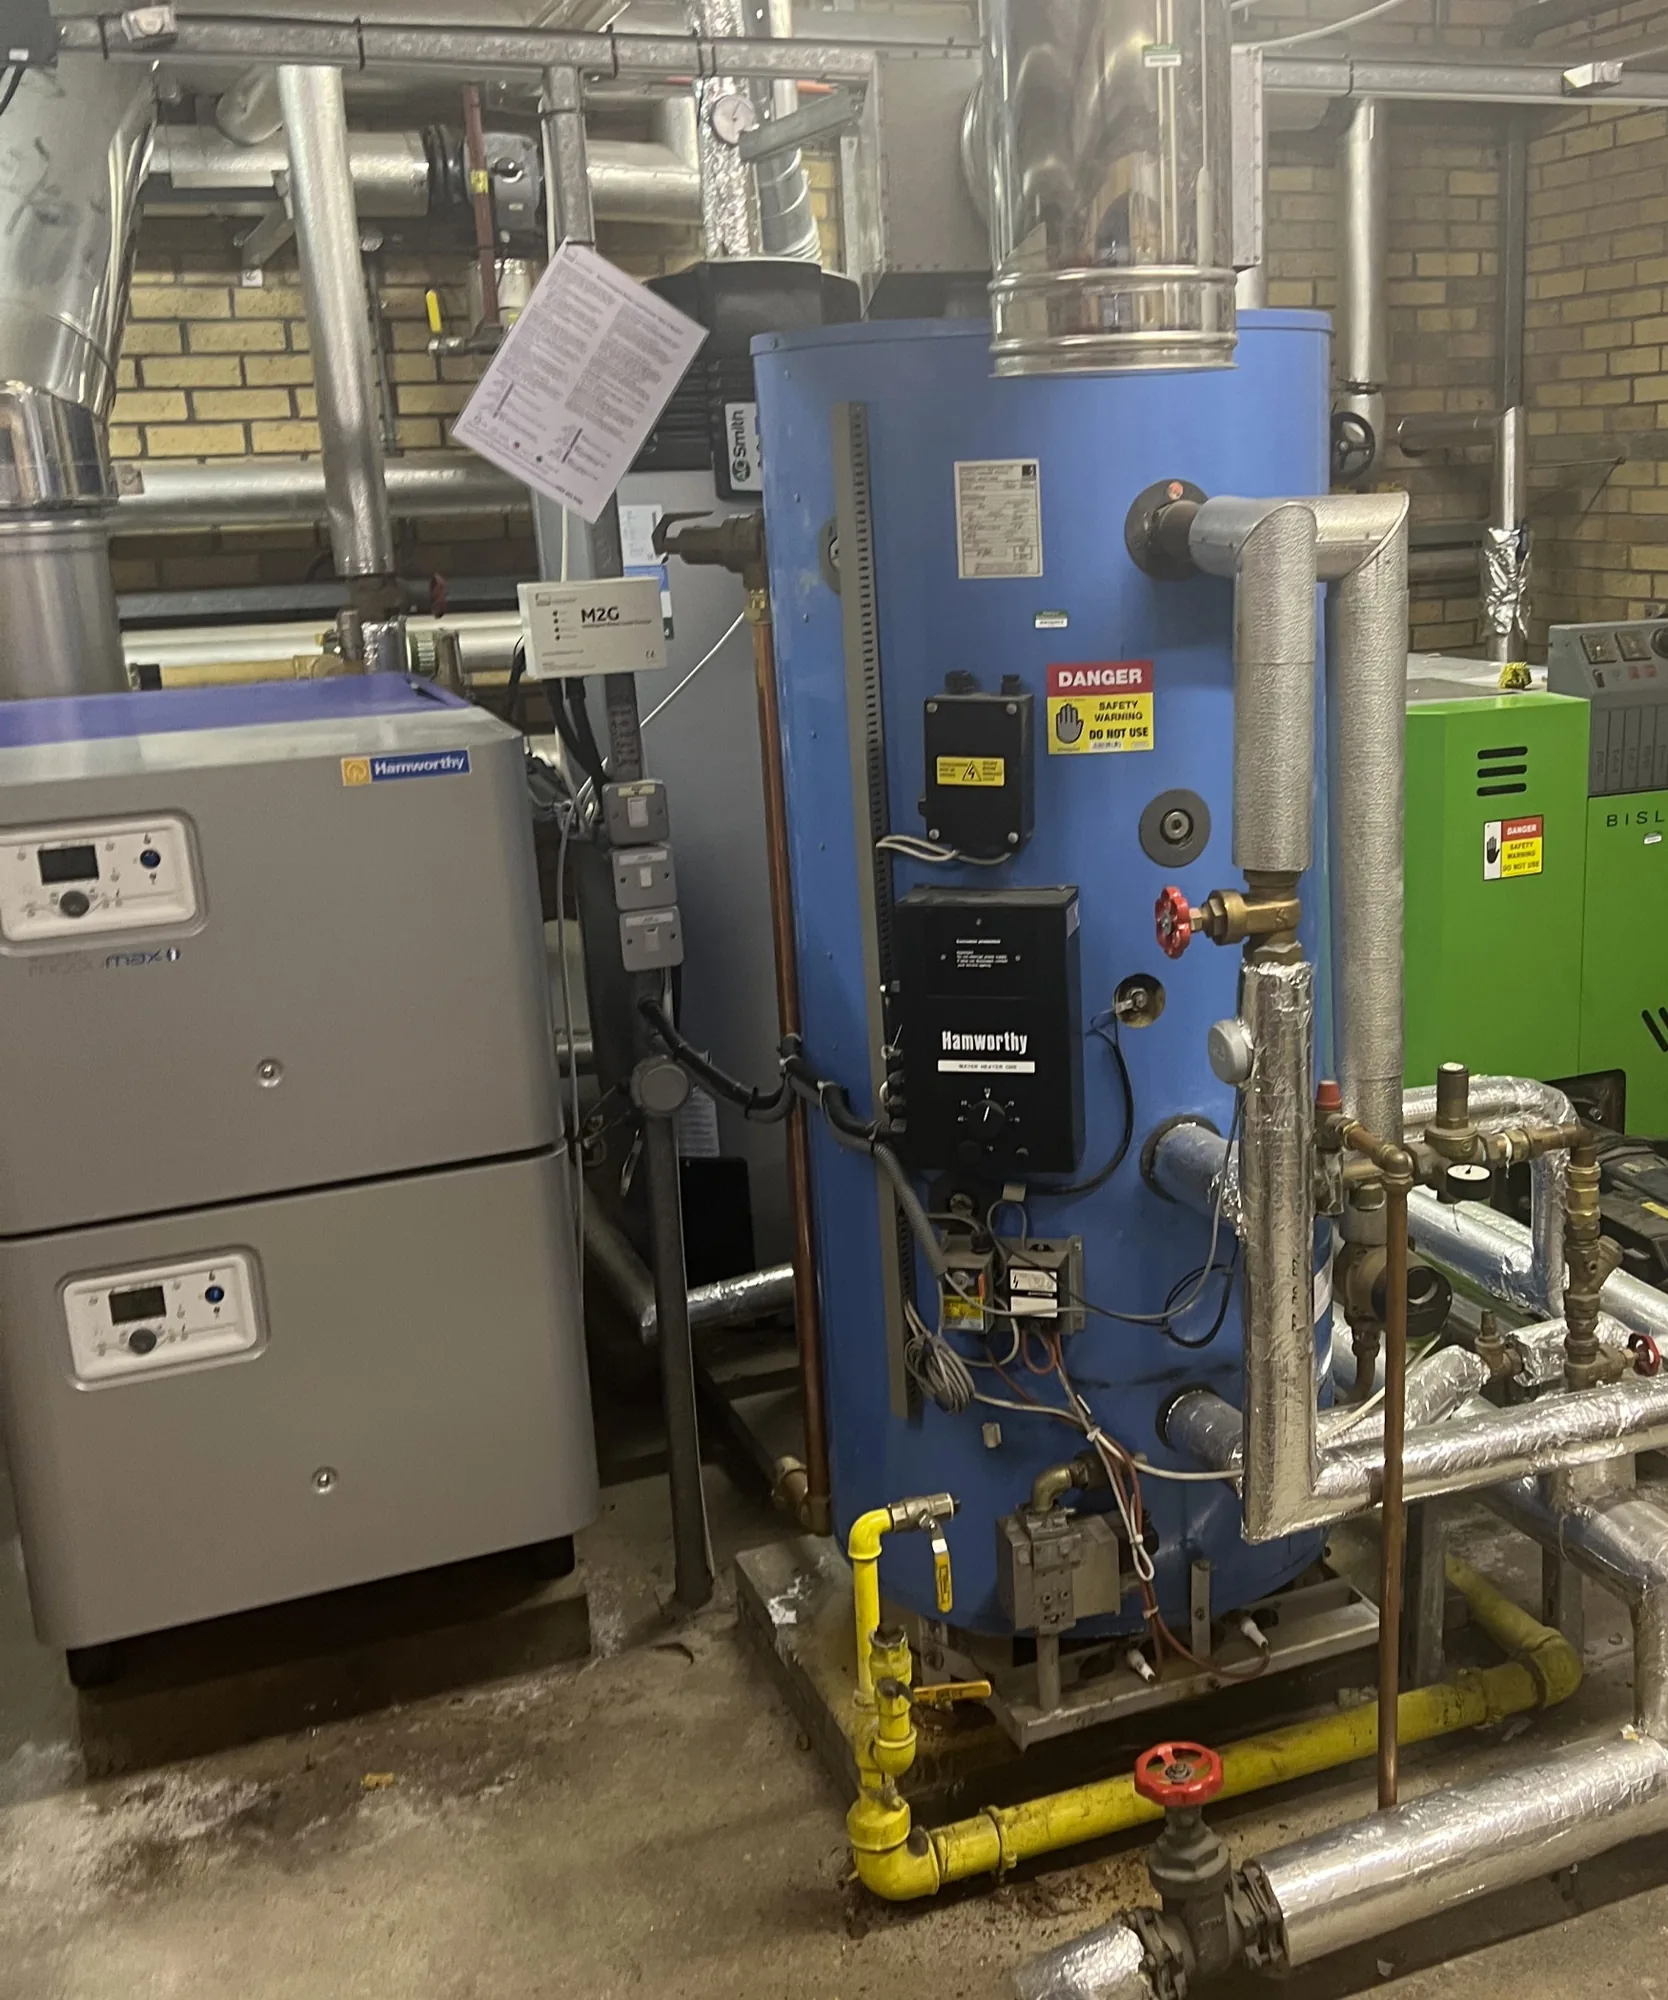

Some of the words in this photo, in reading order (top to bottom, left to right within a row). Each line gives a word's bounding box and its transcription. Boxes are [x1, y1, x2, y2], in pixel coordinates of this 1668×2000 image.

[730, 409, 747, 458] Smith
[581, 606, 620, 623] M2G
[1058, 668, 1142, 688] DANGER
[1099, 700, 1138, 711] SAFETY
[1094, 712, 1143, 722] WARNING
[1089, 729, 1103, 740] DO
[1106, 728, 1127, 739] NOT
[1129, 727, 1148, 738] USE
[374, 755, 465, 775] Hamworthy
[1507, 824, 1537, 835] DANGER
[1510, 842, 1534, 851] SAFETY
[1507, 850, 1536, 860] WARNING
[1502, 864, 1512, 872] DO
[1513, 862, 1526, 871] NOT
[1527, 861, 1540, 869] USE
[941, 1030, 1028, 1055] Hamworthy
